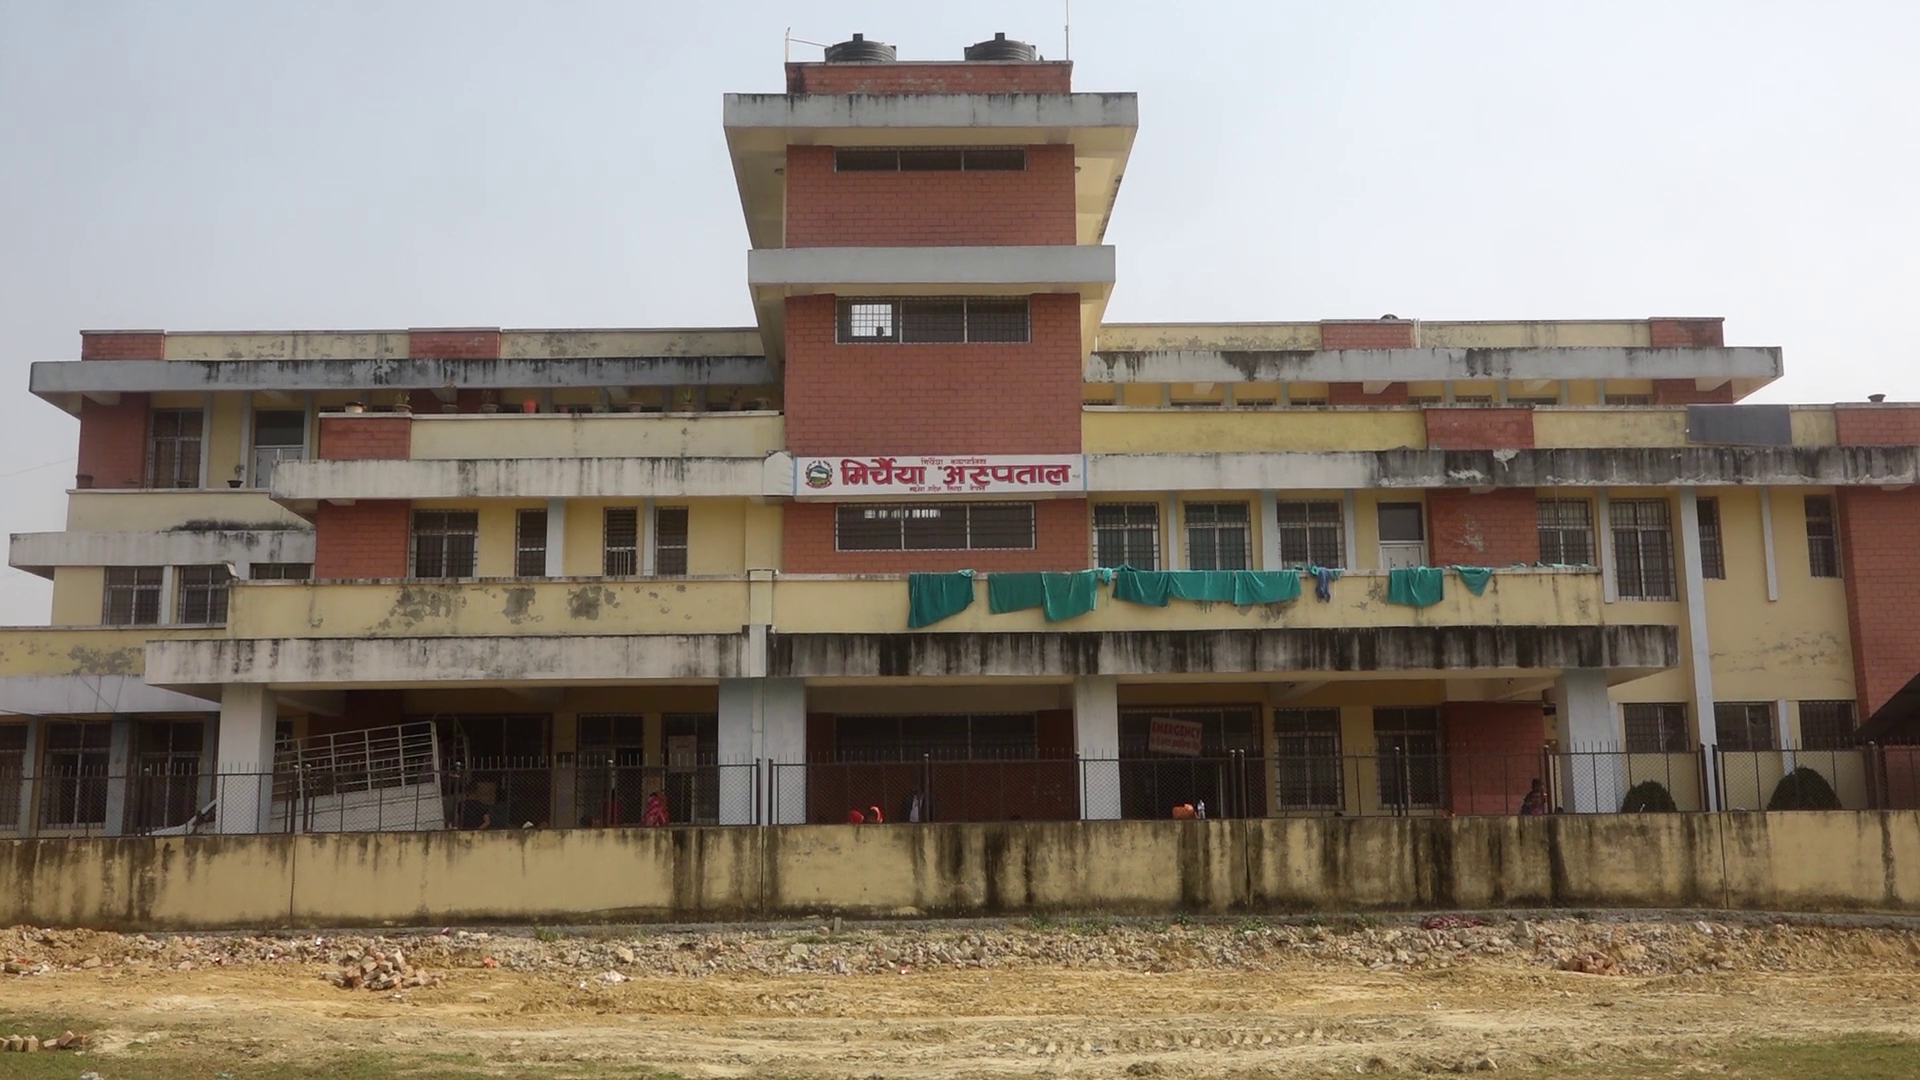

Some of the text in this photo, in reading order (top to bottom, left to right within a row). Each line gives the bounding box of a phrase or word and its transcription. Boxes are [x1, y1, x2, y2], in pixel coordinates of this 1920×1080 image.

[840, 457, 1072, 487] मिर्चैया अस्पताल
[1152, 721, 1201, 738] EMERGENCY
